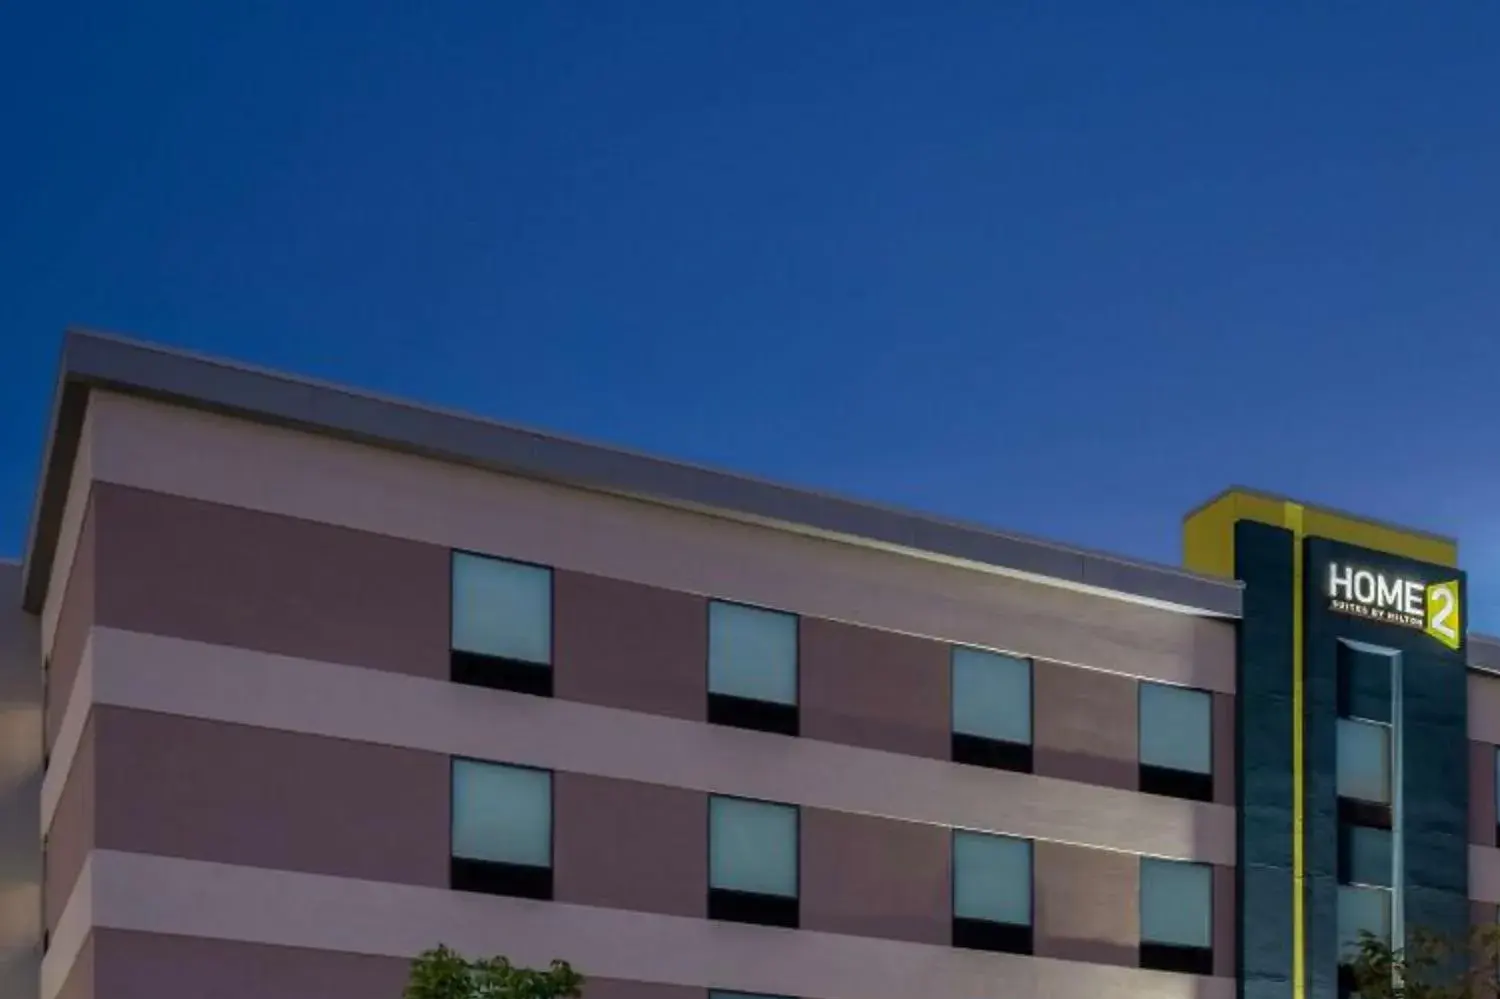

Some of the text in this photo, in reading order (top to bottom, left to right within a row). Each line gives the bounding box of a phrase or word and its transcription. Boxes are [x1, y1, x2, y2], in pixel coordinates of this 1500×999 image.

[1329, 562, 1455, 639] HOME 2
[1332, 599, 1423, 625] SUITES BY HILTON
